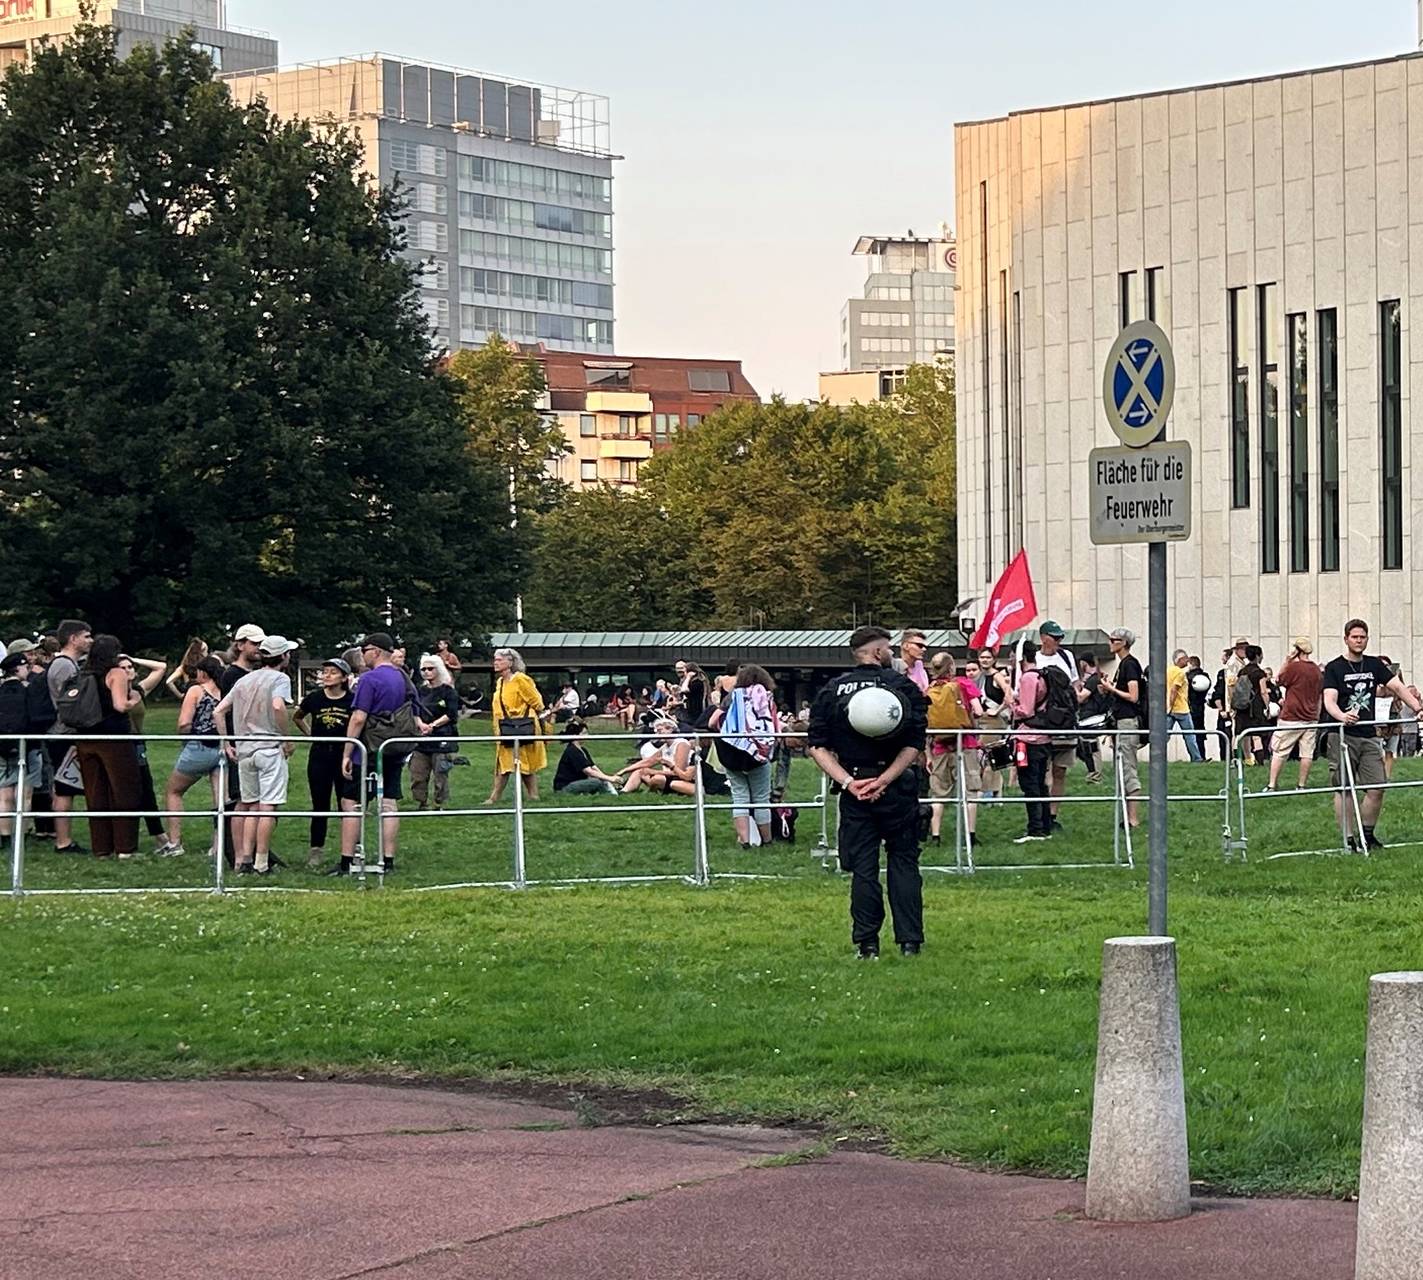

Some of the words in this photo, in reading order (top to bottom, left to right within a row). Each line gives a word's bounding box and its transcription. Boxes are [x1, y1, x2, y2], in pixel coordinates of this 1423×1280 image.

[1097, 459, 1137, 485] Fläche
[1141, 457, 1160, 482] für
[1164, 455, 1183, 480] die
[1106, 492, 1174, 520] Feuerwehr
